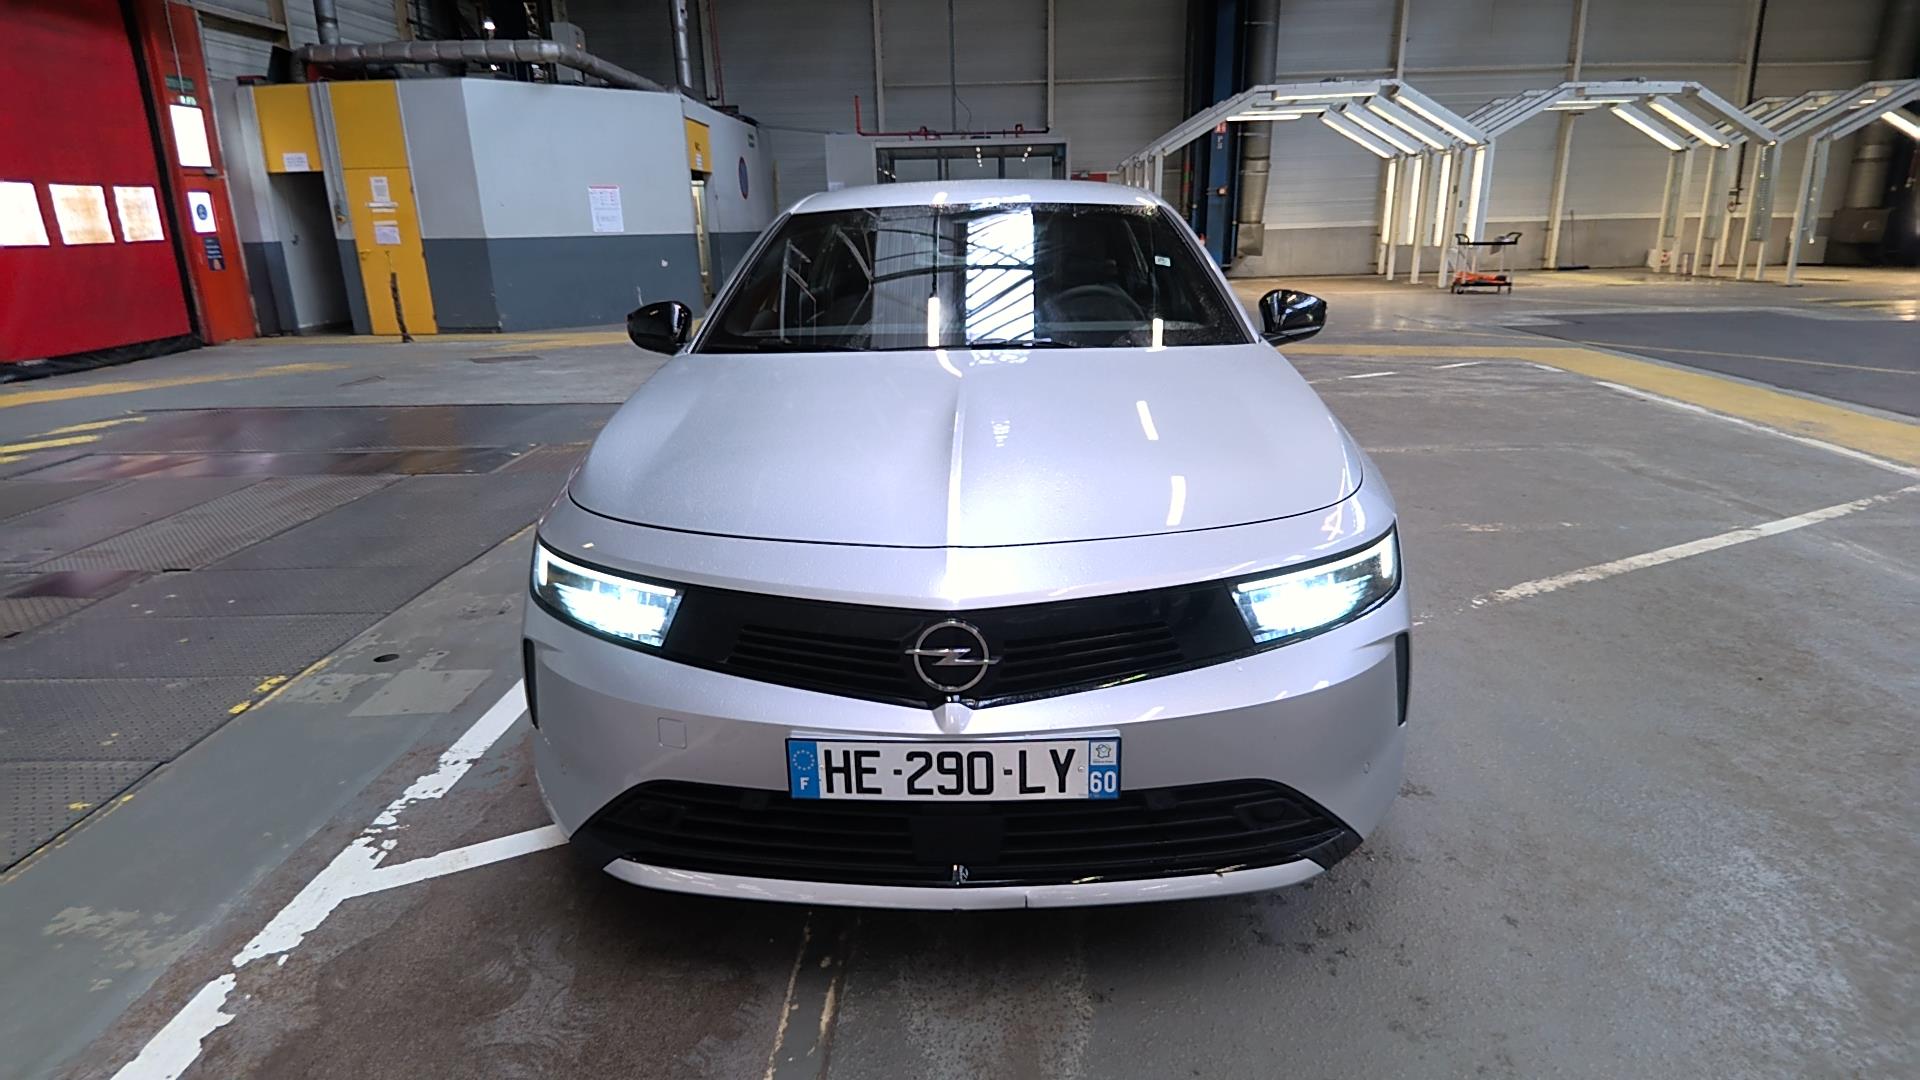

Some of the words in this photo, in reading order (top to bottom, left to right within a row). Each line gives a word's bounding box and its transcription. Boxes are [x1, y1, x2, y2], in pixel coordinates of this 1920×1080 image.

[800, 776, 810, 790] F
[823, 748, 1077, 795] HE-290-LY
[1090, 770, 1117, 793] 60
